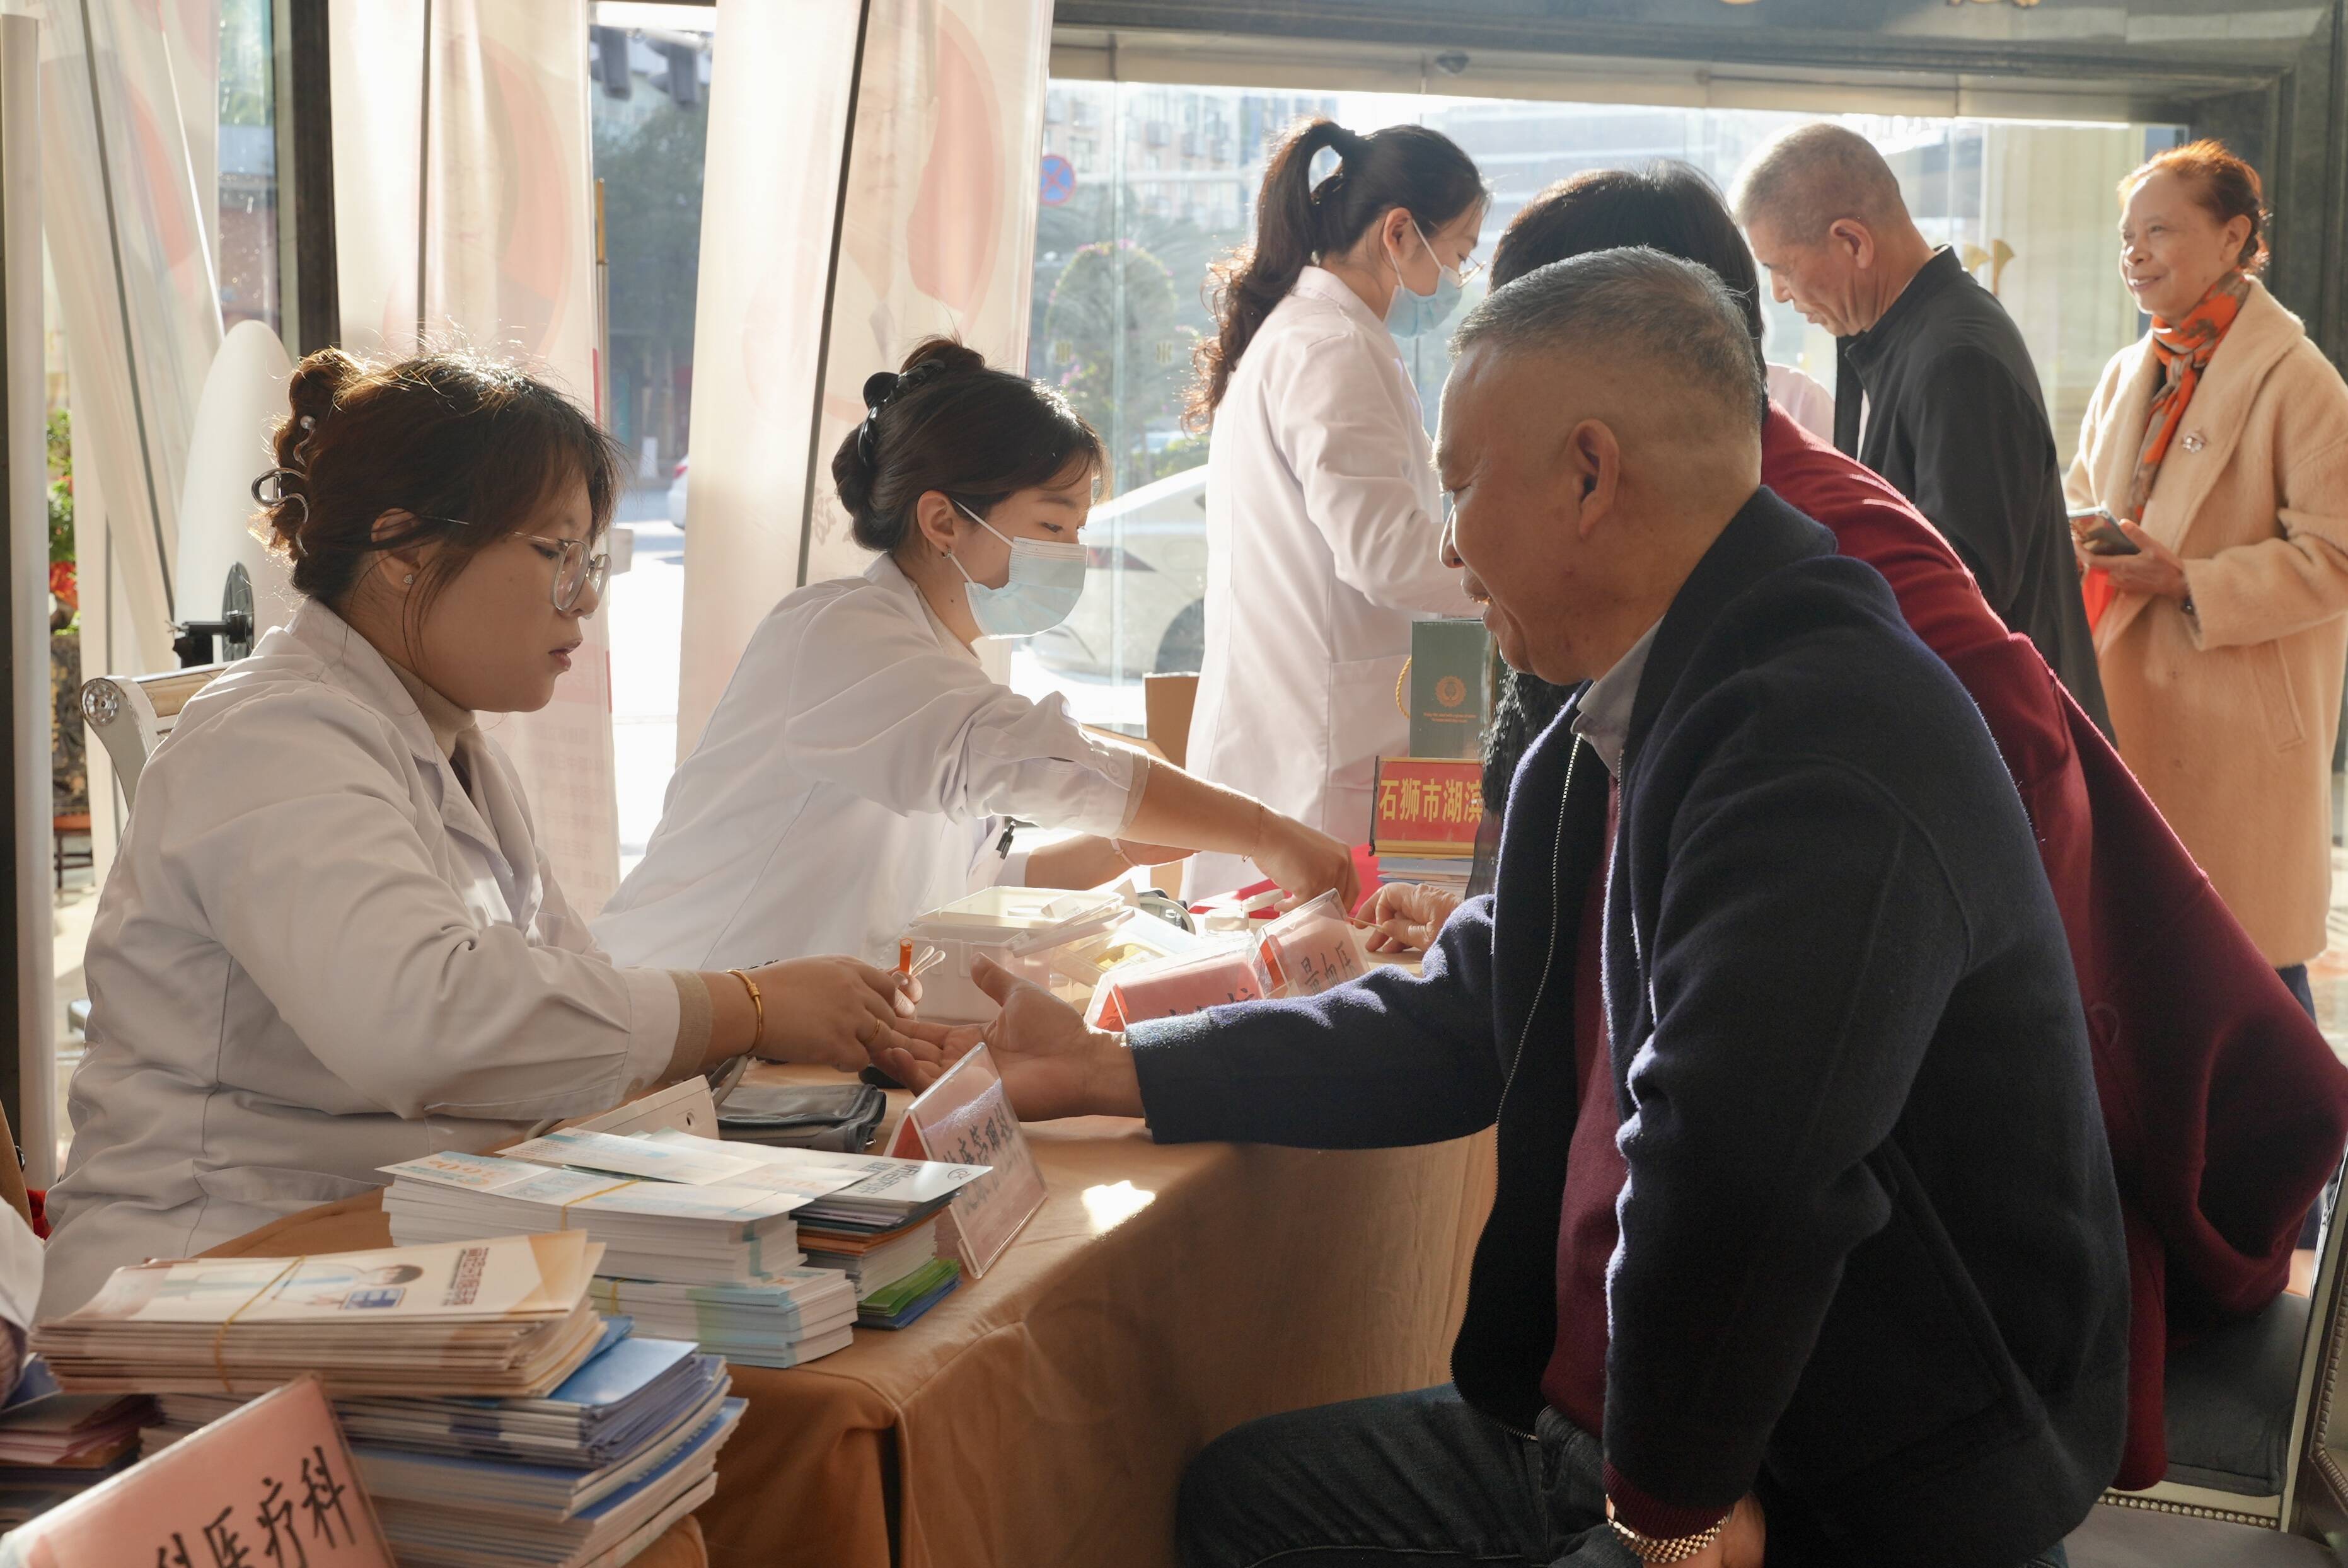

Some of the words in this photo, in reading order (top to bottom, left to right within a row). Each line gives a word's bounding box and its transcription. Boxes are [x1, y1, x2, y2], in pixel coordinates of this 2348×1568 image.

[1379, 778, 1483, 823] 石狮市湖滨
[1301, 940, 1356, 994] 量血压
